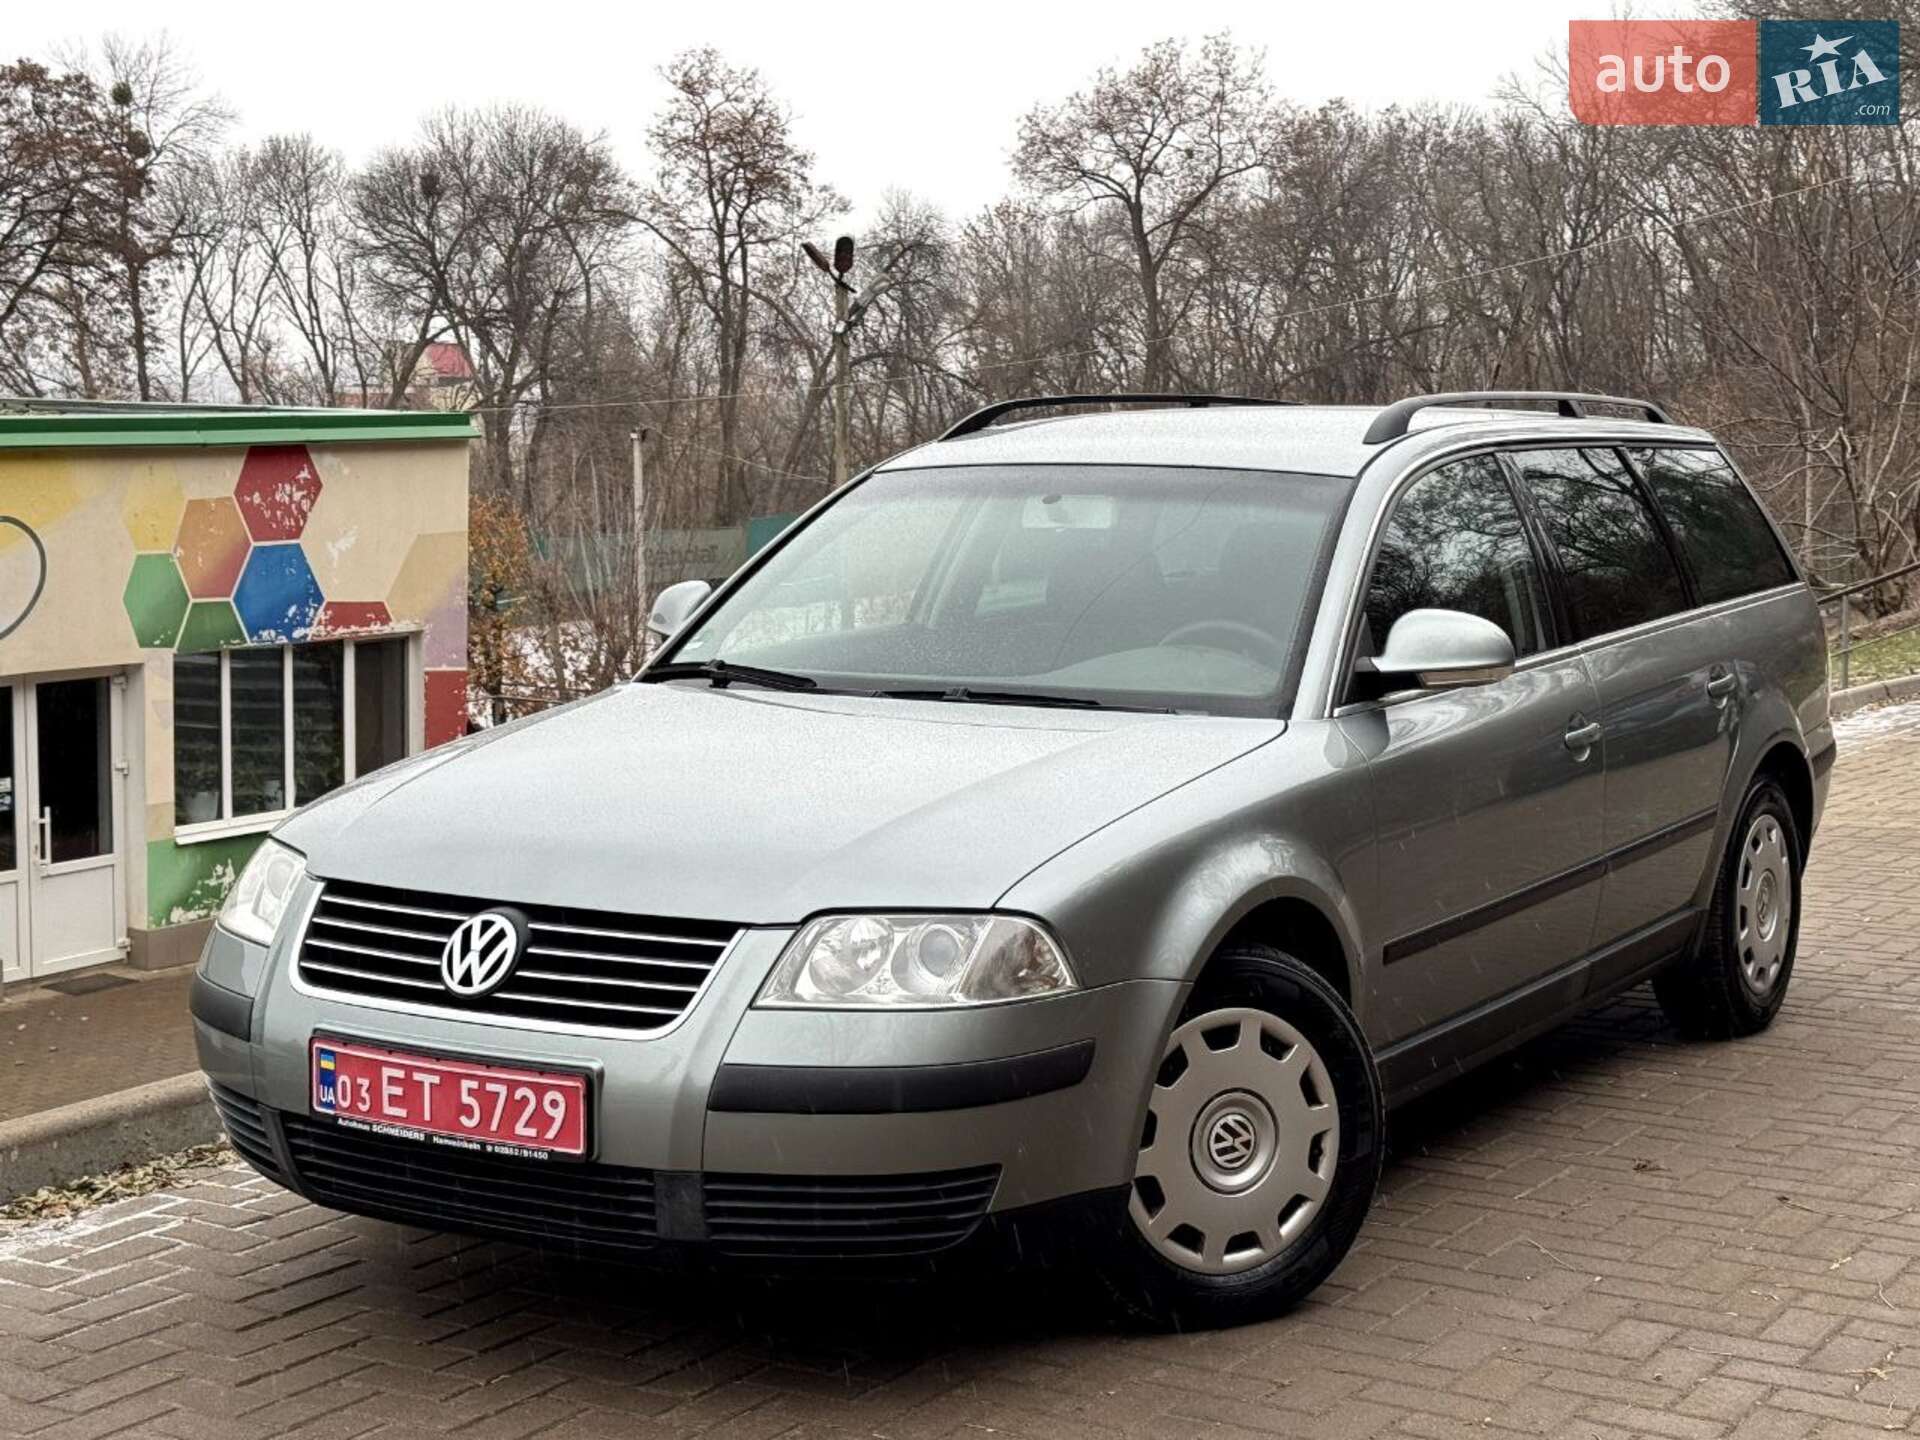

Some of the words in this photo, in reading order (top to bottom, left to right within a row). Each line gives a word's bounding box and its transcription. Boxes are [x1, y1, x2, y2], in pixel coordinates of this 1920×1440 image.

[319, 1084, 336, 1105] UA
[337, 1075, 371, 1112] 03
[381, 1066, 440, 1121] ET
[459, 1080, 567, 1140] 5729
[371, 1124, 425, 1141] SCHNEIDERS
